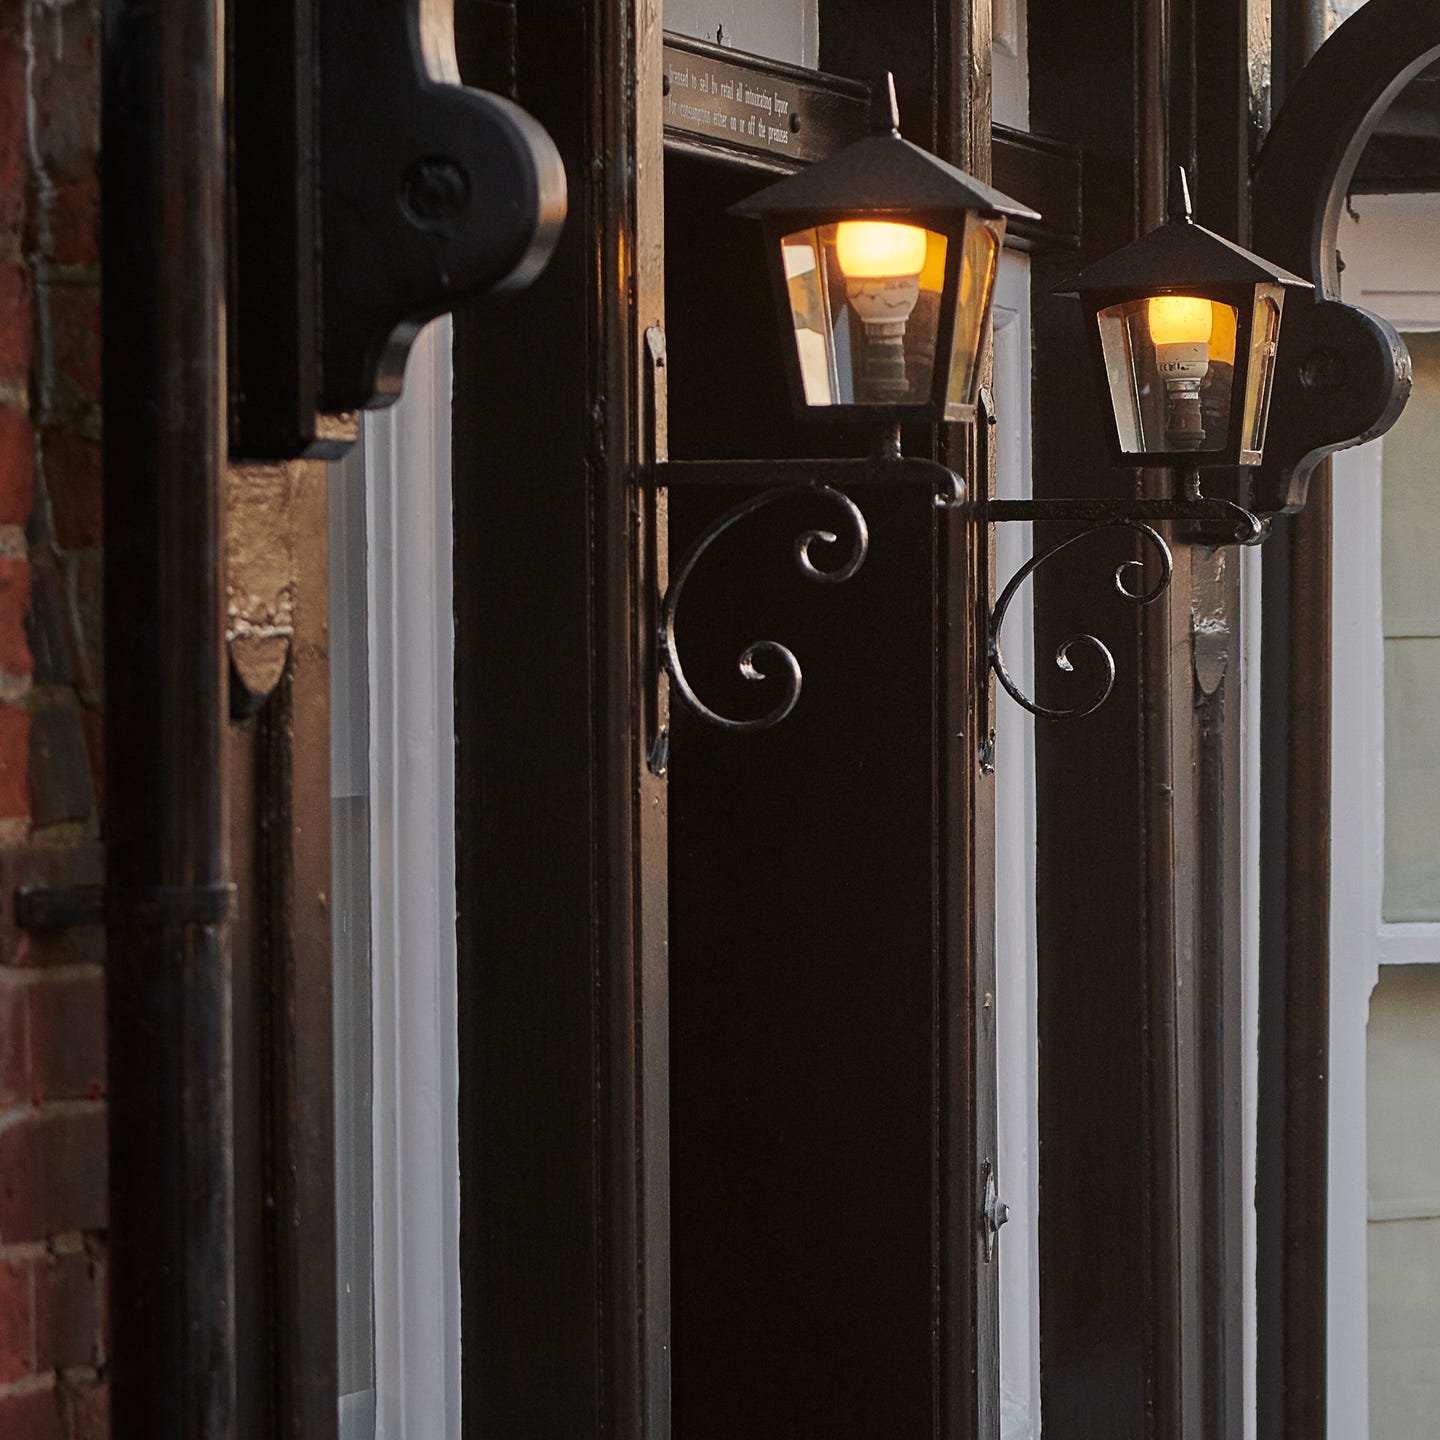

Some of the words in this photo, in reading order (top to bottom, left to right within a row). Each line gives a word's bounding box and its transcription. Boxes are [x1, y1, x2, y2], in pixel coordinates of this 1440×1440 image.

[691, 73, 697, 90] to
[700, 72, 709, 93] sell
[712, 74, 718, 95] by
[721, 79, 734, 101] retail
[745, 83, 772, 116] intoxicating
[774, 91, 788, 117] liquor
[680, 103, 711, 127] consumption
[714, 107, 728, 129] either
[730, 116, 737, 132] on
[740, 119, 745, 133] or
[748, 115, 756, 136] off
[758, 117, 766, 138] the
[768, 123, 788, 145] premises
